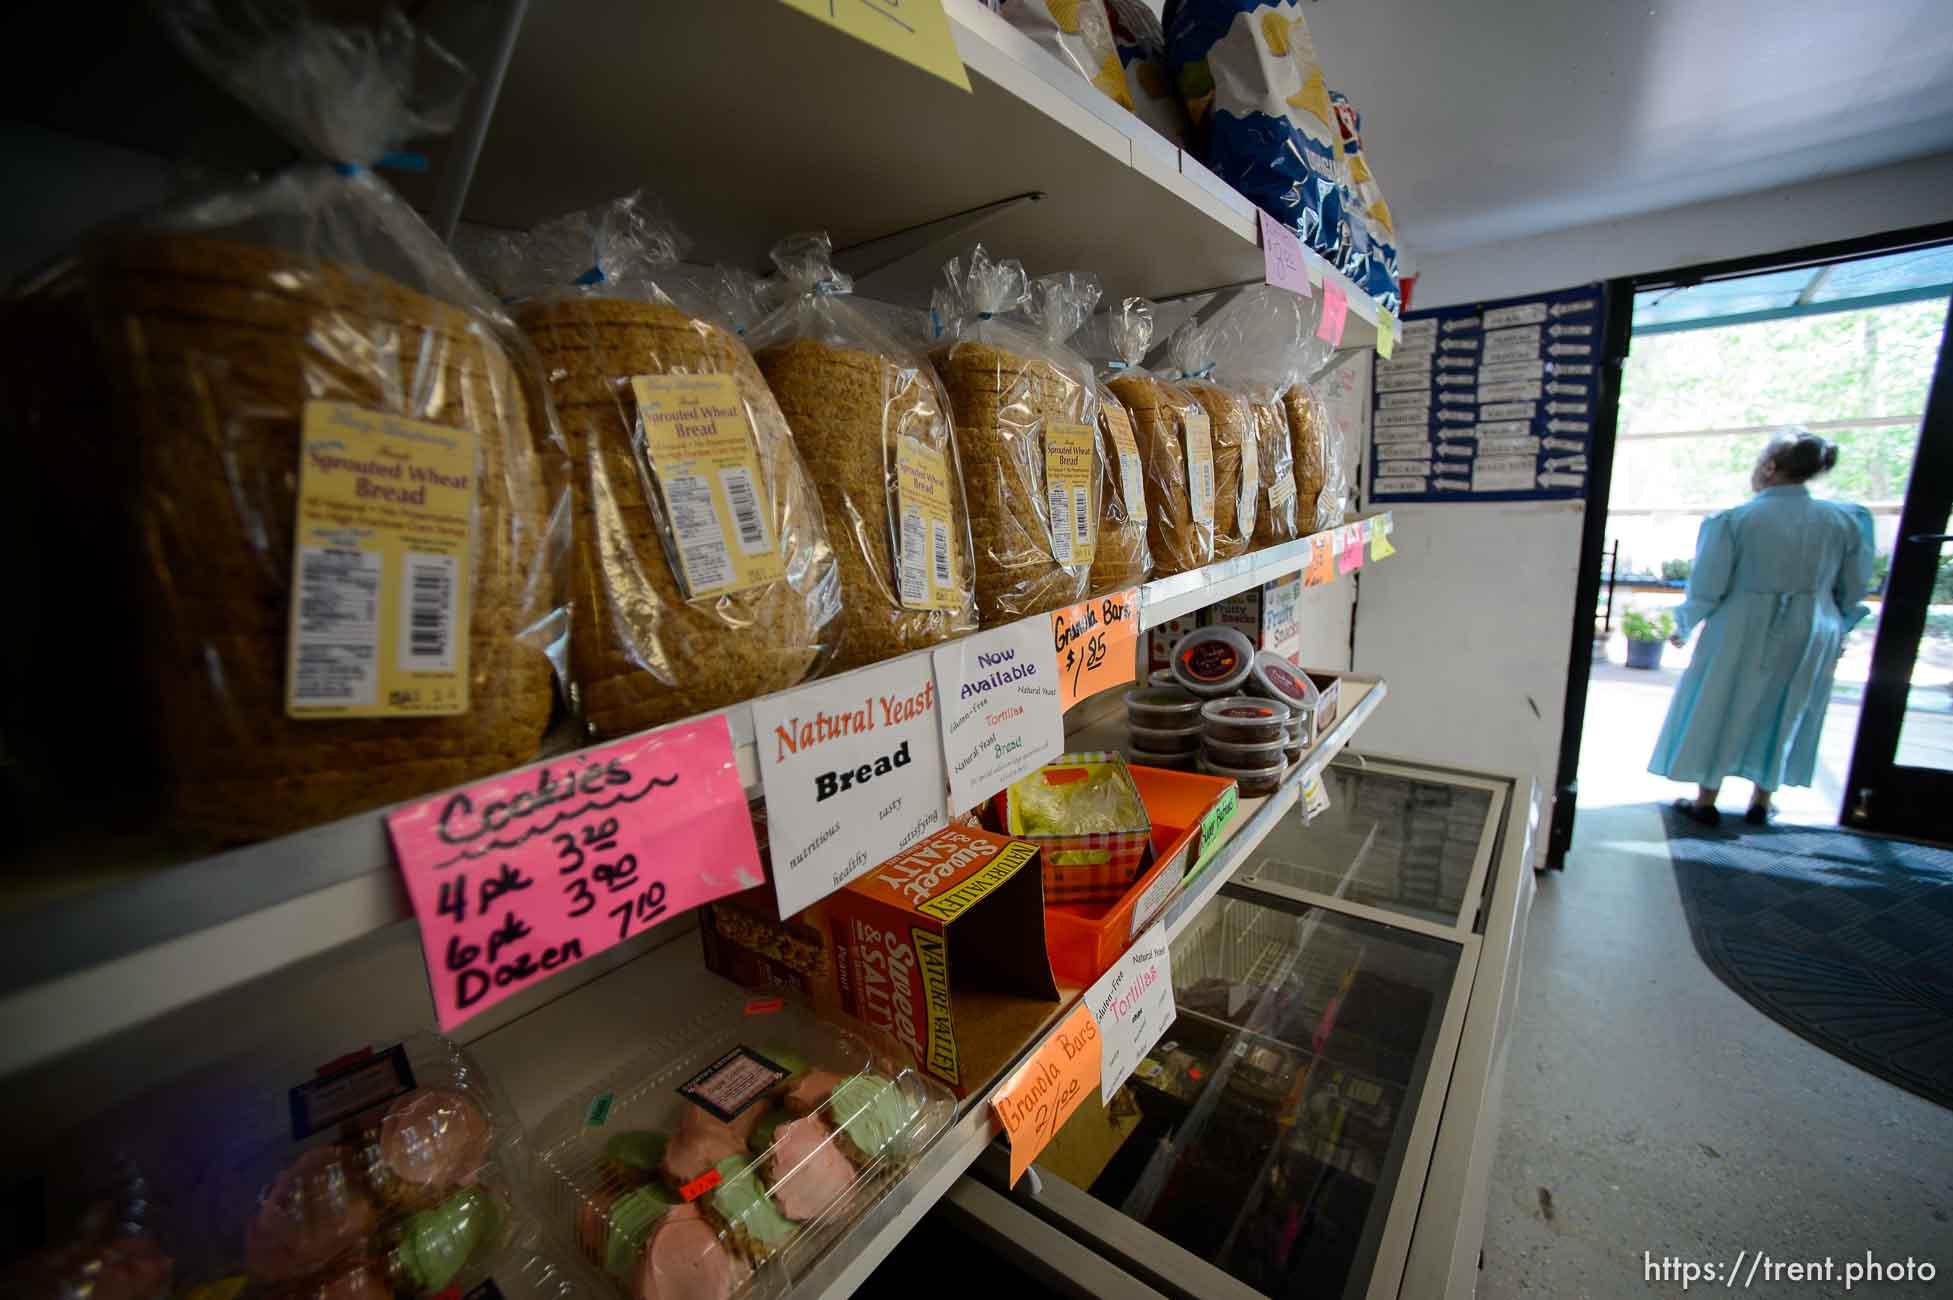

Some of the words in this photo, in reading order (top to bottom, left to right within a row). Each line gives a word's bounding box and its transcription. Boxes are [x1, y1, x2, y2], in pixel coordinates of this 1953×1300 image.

[676, 420, 718, 438] Bread
[356, 477, 426, 504] Bread
[1102, 599, 1131, 625] Bars
[960, 663, 1037, 699] Available
[773, 697, 875, 764] Natural
[880, 679, 935, 728] Yeast
[814, 740, 912, 803] Bread
[954, 744, 978, 774] Natural
[438, 757, 633, 844] Cookies
[878, 797, 903, 821] tasty
[788, 820, 841, 870] nutritious
[897, 809, 939, 851] satisfying
[832, 850, 868, 889] healthy
[879, 840, 959, 890] SALTY
[981, 843, 1035, 881] NATURE
[435, 874, 467, 923] 4
[478, 863, 534, 915] pk
[903, 839, 998, 905] Sweet
[928, 879, 993, 917] VALLEY
[446, 936, 479, 972] 6
[487, 912, 534, 963] pk
[456, 938, 583, 1010] Dozen
[885, 931, 924, 1064] Sweet
[918, 934, 950, 1013] NATURE
[1110, 964, 1158, 1025] Tortillas
[932, 1016, 957, 1082] VALLEY
[1000, 1059, 1060, 1135] Granola
[1056, 1021, 1097, 1060] Bars
